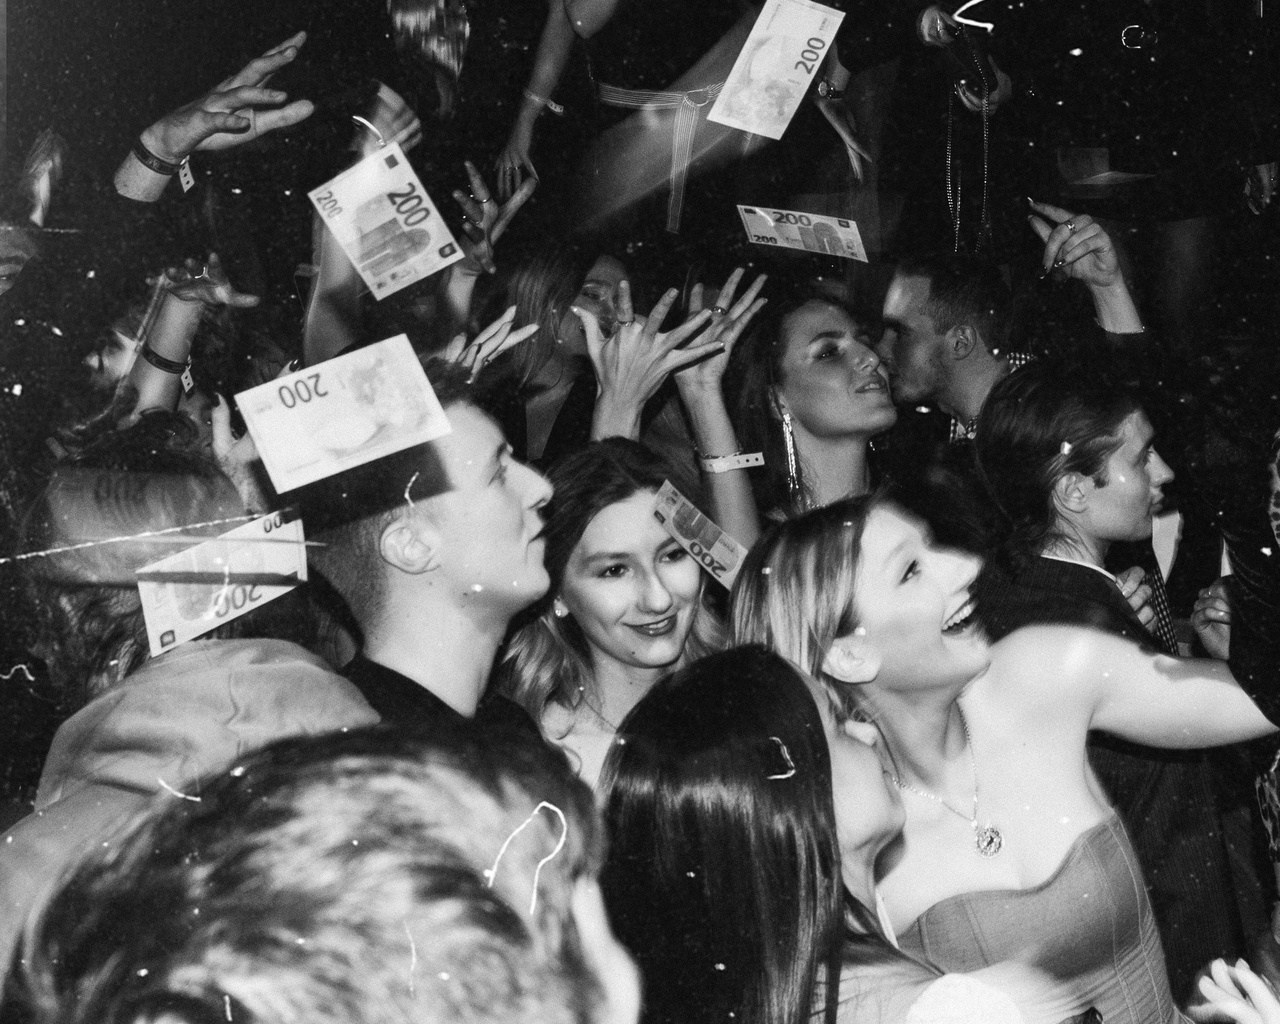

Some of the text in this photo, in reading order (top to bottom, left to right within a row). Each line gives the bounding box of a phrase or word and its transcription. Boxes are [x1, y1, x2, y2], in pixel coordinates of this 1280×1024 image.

[794, 37, 826, 75] 200
[316, 191, 343, 219] 200
[387, 182, 430, 227] 200
[773, 211, 812, 227] 200
[753, 235, 778, 245] 200
[278, 373, 328, 409] 200
[263, 513, 284, 534] 00
[689, 541, 728, 579] 200
